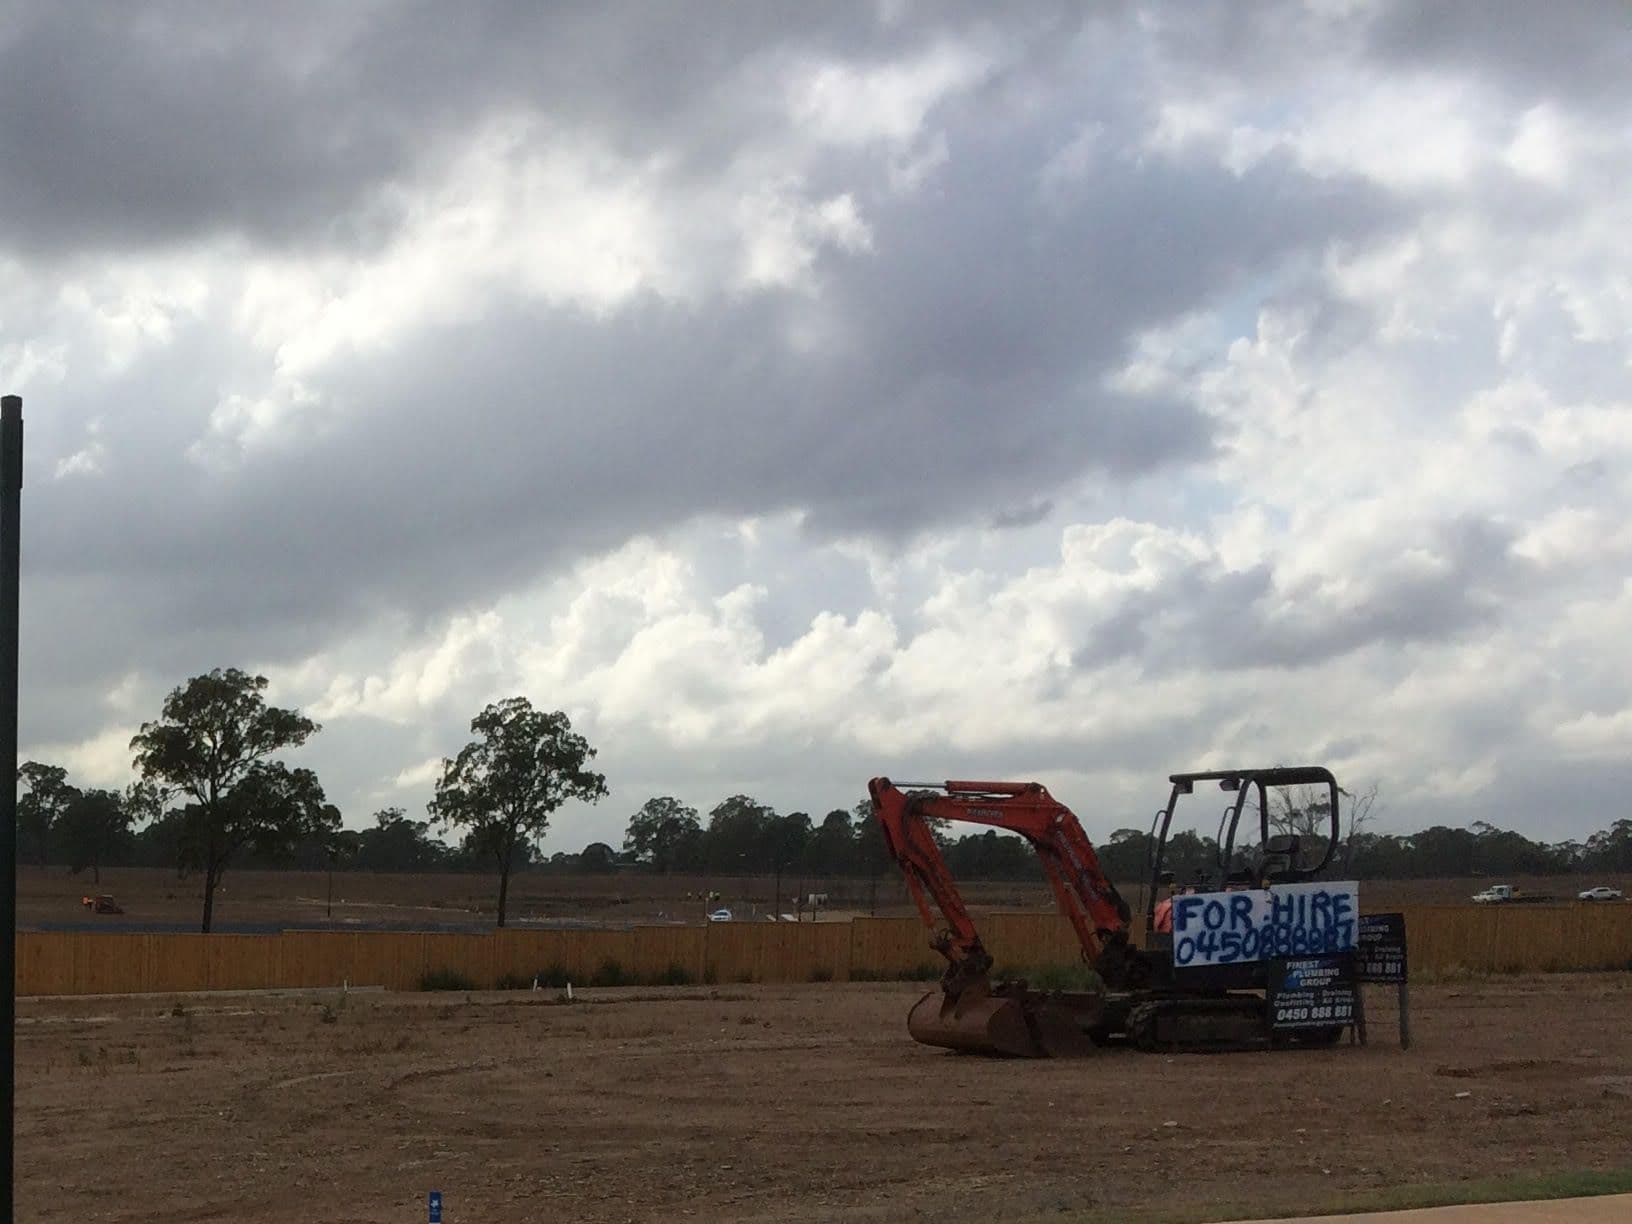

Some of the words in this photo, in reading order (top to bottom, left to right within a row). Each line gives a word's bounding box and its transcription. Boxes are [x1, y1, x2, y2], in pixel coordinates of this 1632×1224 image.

[1175, 895, 1254, 932] FOR
[1271, 890, 1355, 929] HIRE
[1292, 968, 1339, 978] PLUMBING
[1299, 977, 1331, 986] GROUP
[1276, 1007, 1309, 1021] 0450
[1311, 1006, 1332, 1019] 888
[1334, 1005, 1353, 1017] 881
